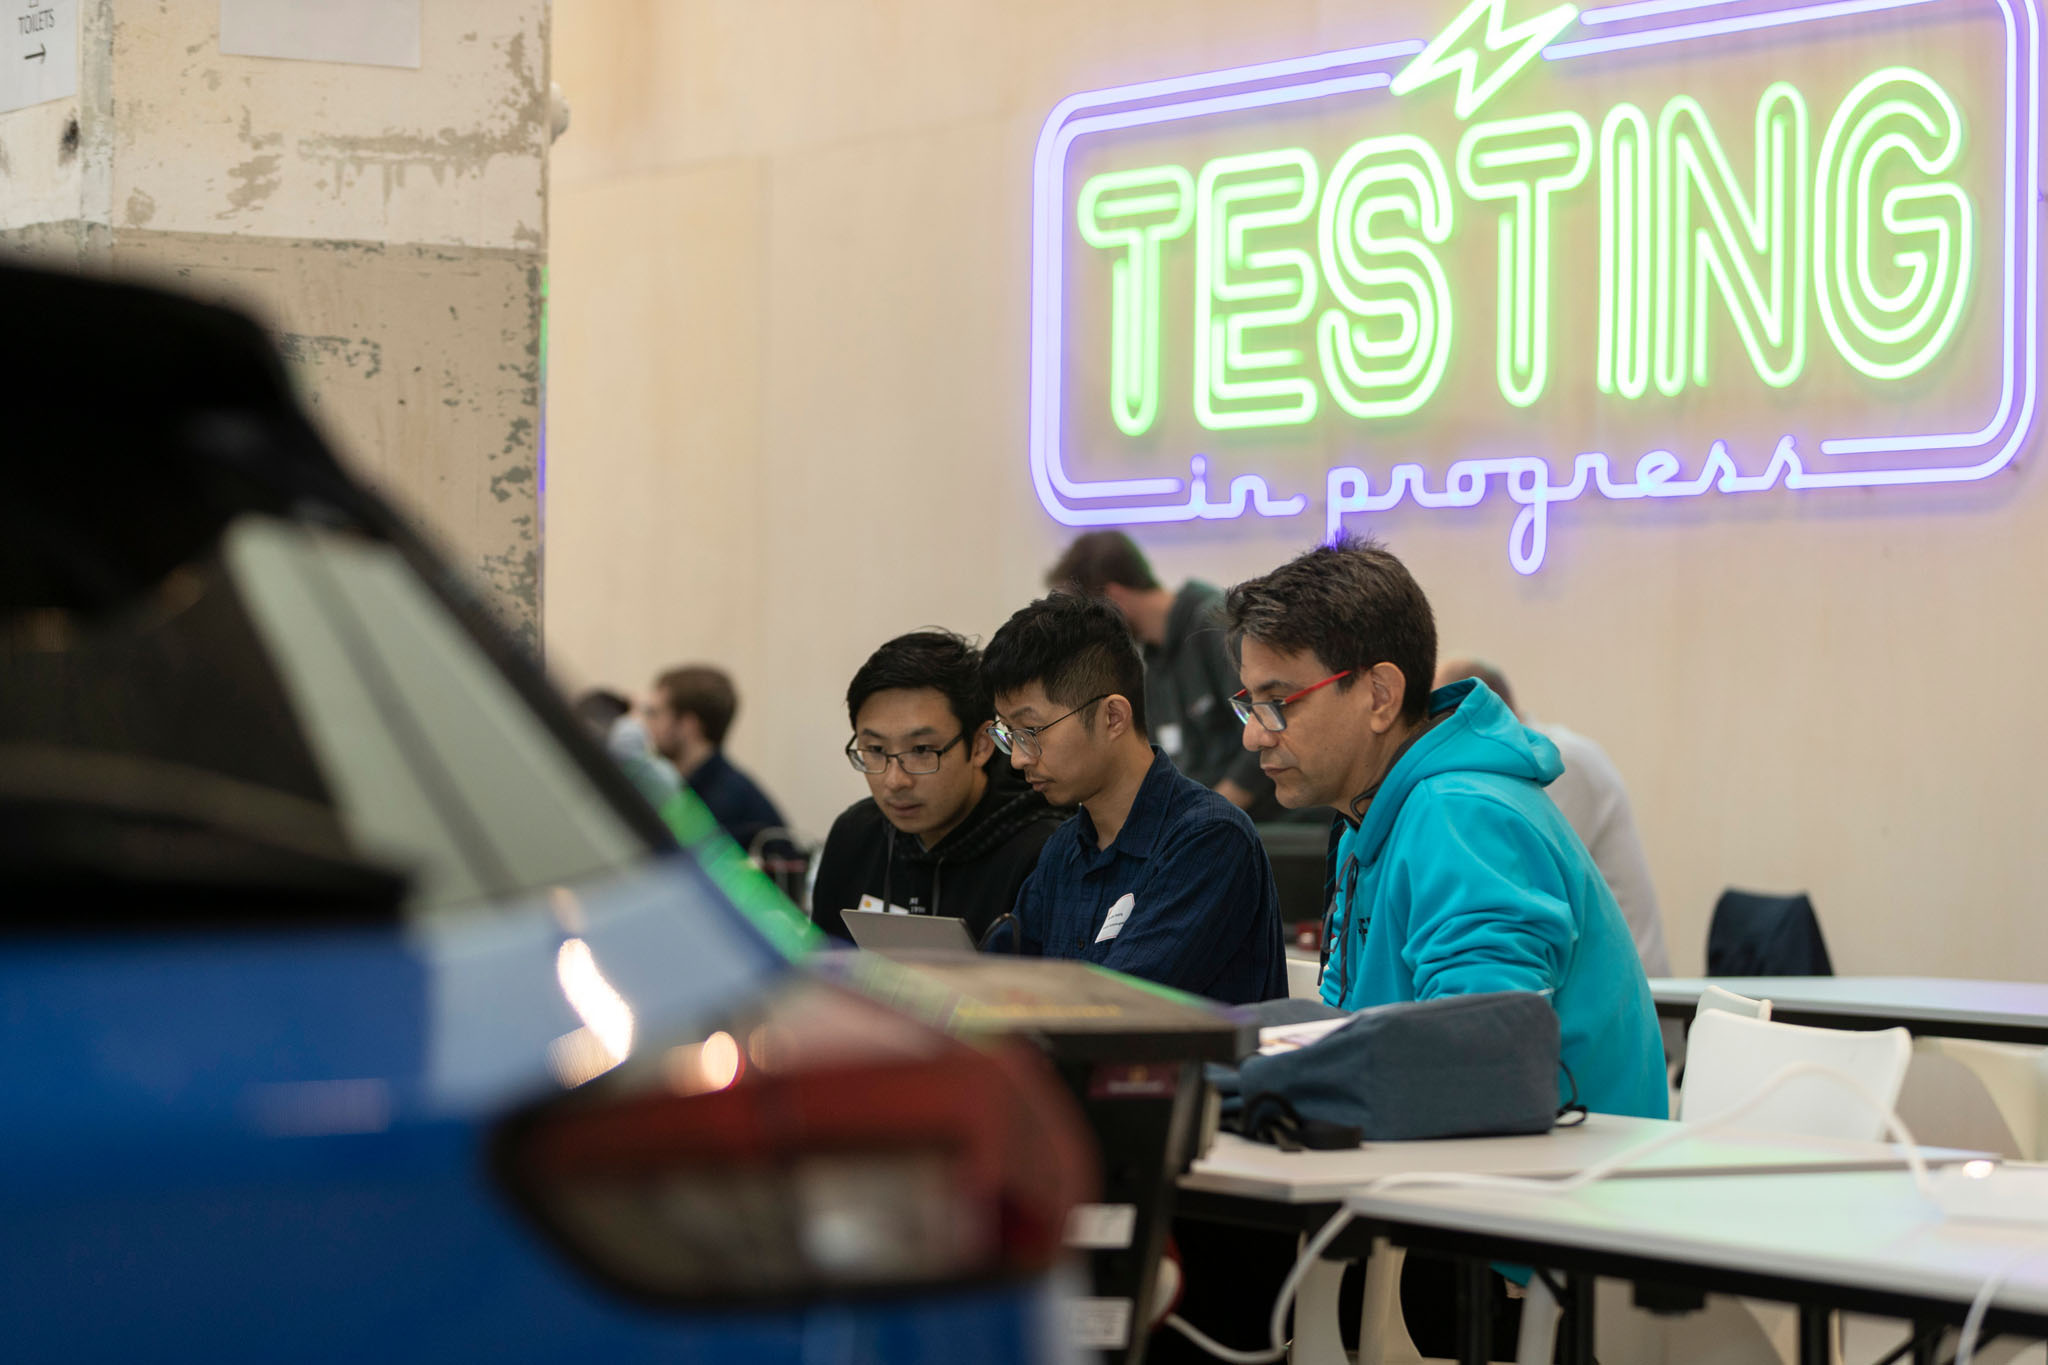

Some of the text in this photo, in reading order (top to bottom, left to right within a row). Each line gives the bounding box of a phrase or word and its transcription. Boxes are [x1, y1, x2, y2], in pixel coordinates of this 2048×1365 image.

[18, 8, 55, 35] TOILETS
[1078, 67, 1974, 435] TESTING
[1188, 434, 1803, 576] in progress
